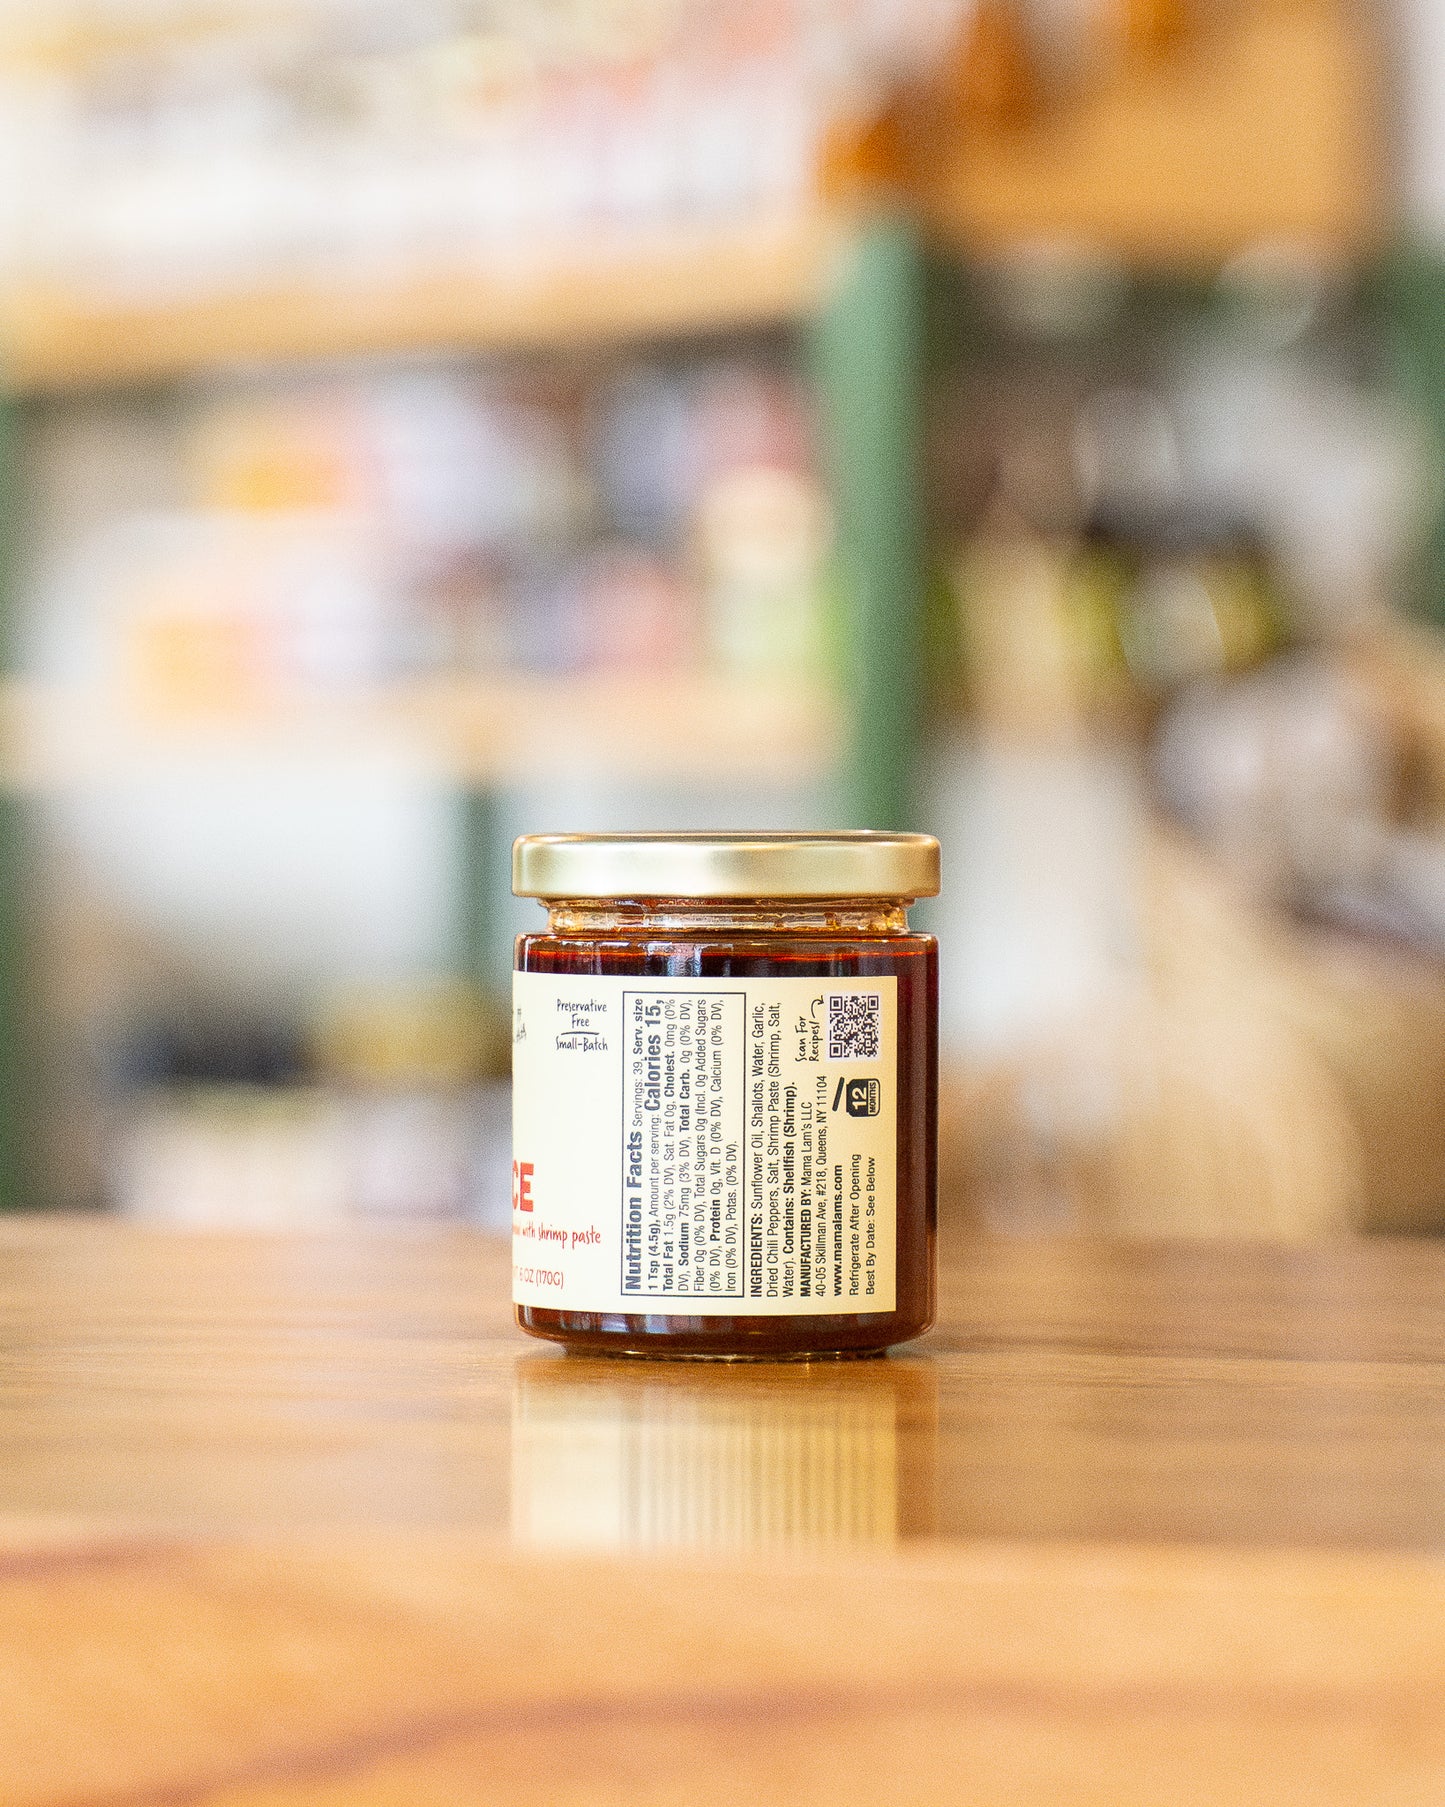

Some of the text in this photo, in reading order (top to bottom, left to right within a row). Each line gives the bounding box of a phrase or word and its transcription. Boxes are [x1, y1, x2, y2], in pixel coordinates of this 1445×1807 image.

[556, 998, 607, 1012] Preservative
[633, 999, 643, 1021] size
[645, 1000, 664, 1027] 15,
[665, 999, 675, 1020] (0%
[696, 1000, 707, 1035] Sugars
[571, 1013, 590, 1028] Free
[555, 1035, 608, 1052] Small-Batch
[633, 1026, 643, 1054] Serv.
[665, 1024, 676, 1047] 0mg
[680, 1025, 691, 1045] (0%
[711, 1026, 722, 1045] (0%
[795, 1016, 807, 1061] Scan For
[809, 1021, 823, 1061] Recipes!
[680, 1051, 691, 1063] 0g
[696, 1039, 706, 1071] Added
[644, 1035, 661, 1111] Calories
[664, 1051, 674, 1097] Cholest.
[680, 1069, 690, 1099] Carb.
[696, 1075, 707, 1087] 0g
[711, 1051, 721, 1092] Calcium
[633, 1079, 644, 1126] Servings:
[695, 1091, 706, 1114] (Incl.
[852, 1087, 867, 1110] 12
[664, 1122, 674, 1137] Fat
[680, 1105, 690, 1132] Total
[695, 1119, 707, 1131] 0g
[649, 1114, 661, 1154] serving:
[711, 1122, 722, 1142] (0%
[627, 1132, 642, 1188] Facts
[664, 1141, 674, 1161] Sat.
[695, 1135, 707, 1171] Sugars
[726, 1141, 737, 1161] DV).
[751, 1003, 765, 1297] INGREDIENTS: Sunflower Oil, Shallots, Water, Garlic,
[767, 1003, 782, 1297] Dried Chili Peppers, Salt, Shrimp Paste (Shrimp, Salt,
[651, 1158, 660, 1174] per
[679, 1162, 690, 1182] (3%
[710, 1159, 720, 1175] Vit.
[726, 1166, 737, 1186] (0%
[649, 1178, 659, 1216] Amount
[664, 1189, 675, 1209] (2%
[695, 1175, 705, 1198] Total
[783, 1082, 797, 1297] Water). Contains: Shellfish (Shrimp).
[816, 1076, 828, 1297] 40-05 Skillman Ave, #218, Queens, NY 11104
[679, 1188, 691, 1217] 75mg
[726, 1189, 736, 1220] Potas.
[800, 1102, 812, 1297] MANUFACTURED BY: Mama Lam's LLC
[664, 1214, 675, 1236] 1.5g
[710, 1200, 720, 1241] Protein
[833, 1165, 842, 1296] www.mamalams.com
[849, 1154, 861, 1295] Refrigerate After Opening
[866, 1157, 877, 1294] Best By Date: See Below
[522, 1221, 535, 1238] with
[538, 1222, 568, 1249] shrimp
[572, 1225, 601, 1250] paste
[626, 1197, 641, 1290] Nutrition
[648, 1220, 660, 1256] (4.5g),
[679, 1223, 689, 1266] Sodium
[695, 1226, 706, 1246] (0%
[664, 1241, 673, 1259] Fat
[695, 1250, 706, 1262] 0g
[726, 1248, 737, 1268] (0%
[536, 1269, 564, 1290] (170G)
[648, 1261, 659, 1280] Tsp
[663, 1264, 673, 1291] Total
[694, 1266, 704, 1291] Fiber
[710, 1271, 721, 1291] (0%
[725, 1273, 736, 1291] Iron
